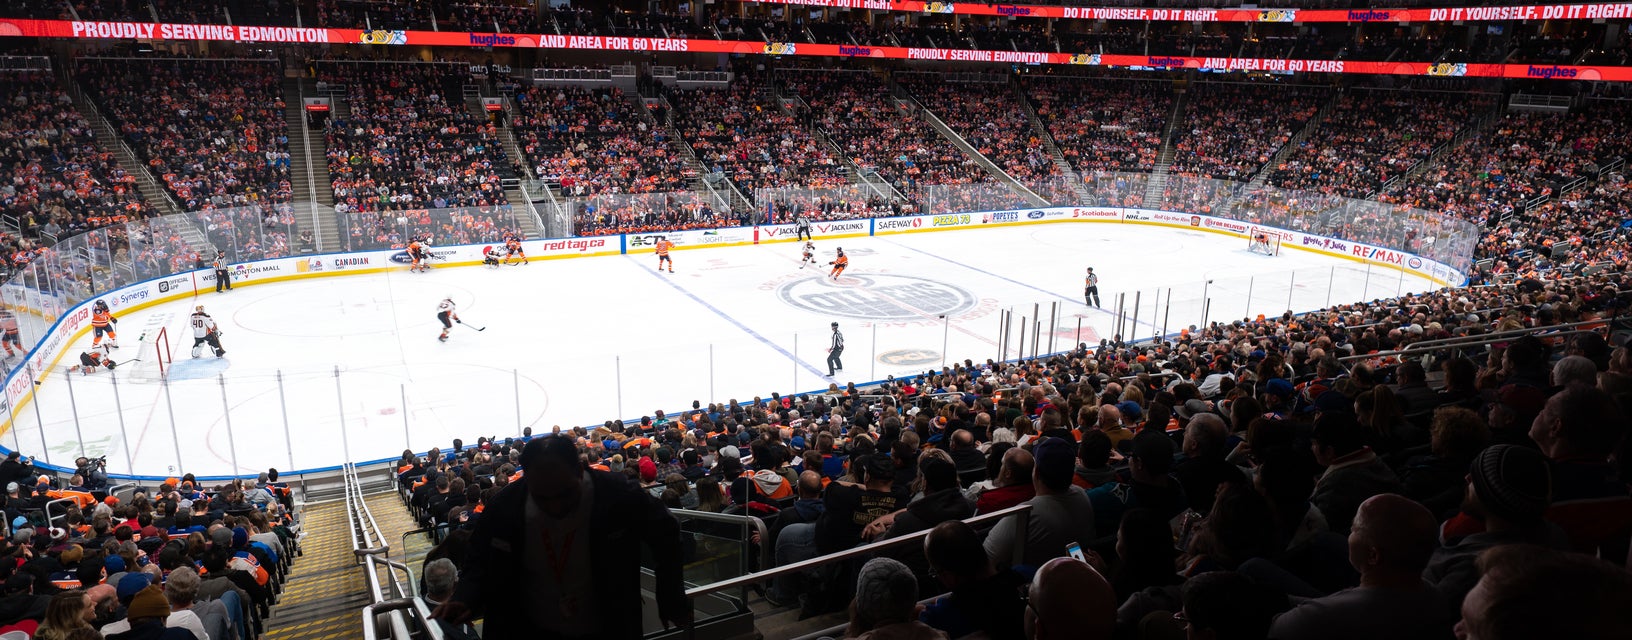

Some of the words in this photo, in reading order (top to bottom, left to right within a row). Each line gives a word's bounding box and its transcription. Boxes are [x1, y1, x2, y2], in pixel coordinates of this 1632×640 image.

[864, 0, 893, 10] RIGHT.
[997, 6, 1030, 16] hughes
[1064, 8, 1078, 18] DO
[1081, 8, 1091, 18] IT
[1093, 8, 1149, 20] YOURSELF,
[1152, 10, 1168, 20] DO
[1170, 10, 1182, 20] IT
[1184, 10, 1218, 22] RIGHT.
[1348, 10, 1390, 22] hughes
[1430, 8, 1448, 20] DO
[1450, 8, 1463, 20] IT
[1466, 6, 1538, 20] YOURSELF,
[1542, 6, 1564, 19] DO
[1567, 5, 1584, 18] IT
[72, 22, 155, 39] PROUDLY
[161, 24, 234, 40] SERVING
[239, 26, 328, 42] EDMONTON
[470, 32, 515, 46] hughes
[540, 35, 566, 48] AND
[569, 36, 602, 49] AREA
[606, 37, 630, 50] FOR
[632, 38, 648, 50] 60
[650, 38, 688, 51] YEARS
[840, 44, 870, 56] hughes
[908, 48, 948, 60] PROUDLY
[950, 49, 992, 62] SERVING
[994, 51, 1048, 63] EDMONTON
[1148, 56, 1184, 67] hughes
[1204, 58, 1227, 68] AND
[1230, 58, 1260, 70] AREA
[1264, 59, 1286, 70] FOR
[1288, 60, 1304, 71] 60
[1306, 60, 1344, 72] YEARS
[1528, 66, 1576, 79] hughes
[878, 220, 912, 230] SAFEWAY
[933, 214, 958, 226] PIZZA
[960, 214, 970, 224] 73
[780, 227, 795, 236] JACK
[1224, 222, 1246, 231] DELIVERY
[544, 240, 565, 251] red
[568, 239, 605, 251] tag.ca
[1353, 244, 1403, 264] RE/MAX
[335, 258, 369, 266] CANADIAN
[227, 266, 261, 277] DMONTON
[169, 276, 189, 286] OFFICIAL
[120, 289, 149, 303] Synergy
[192, 319, 203, 328] 40
